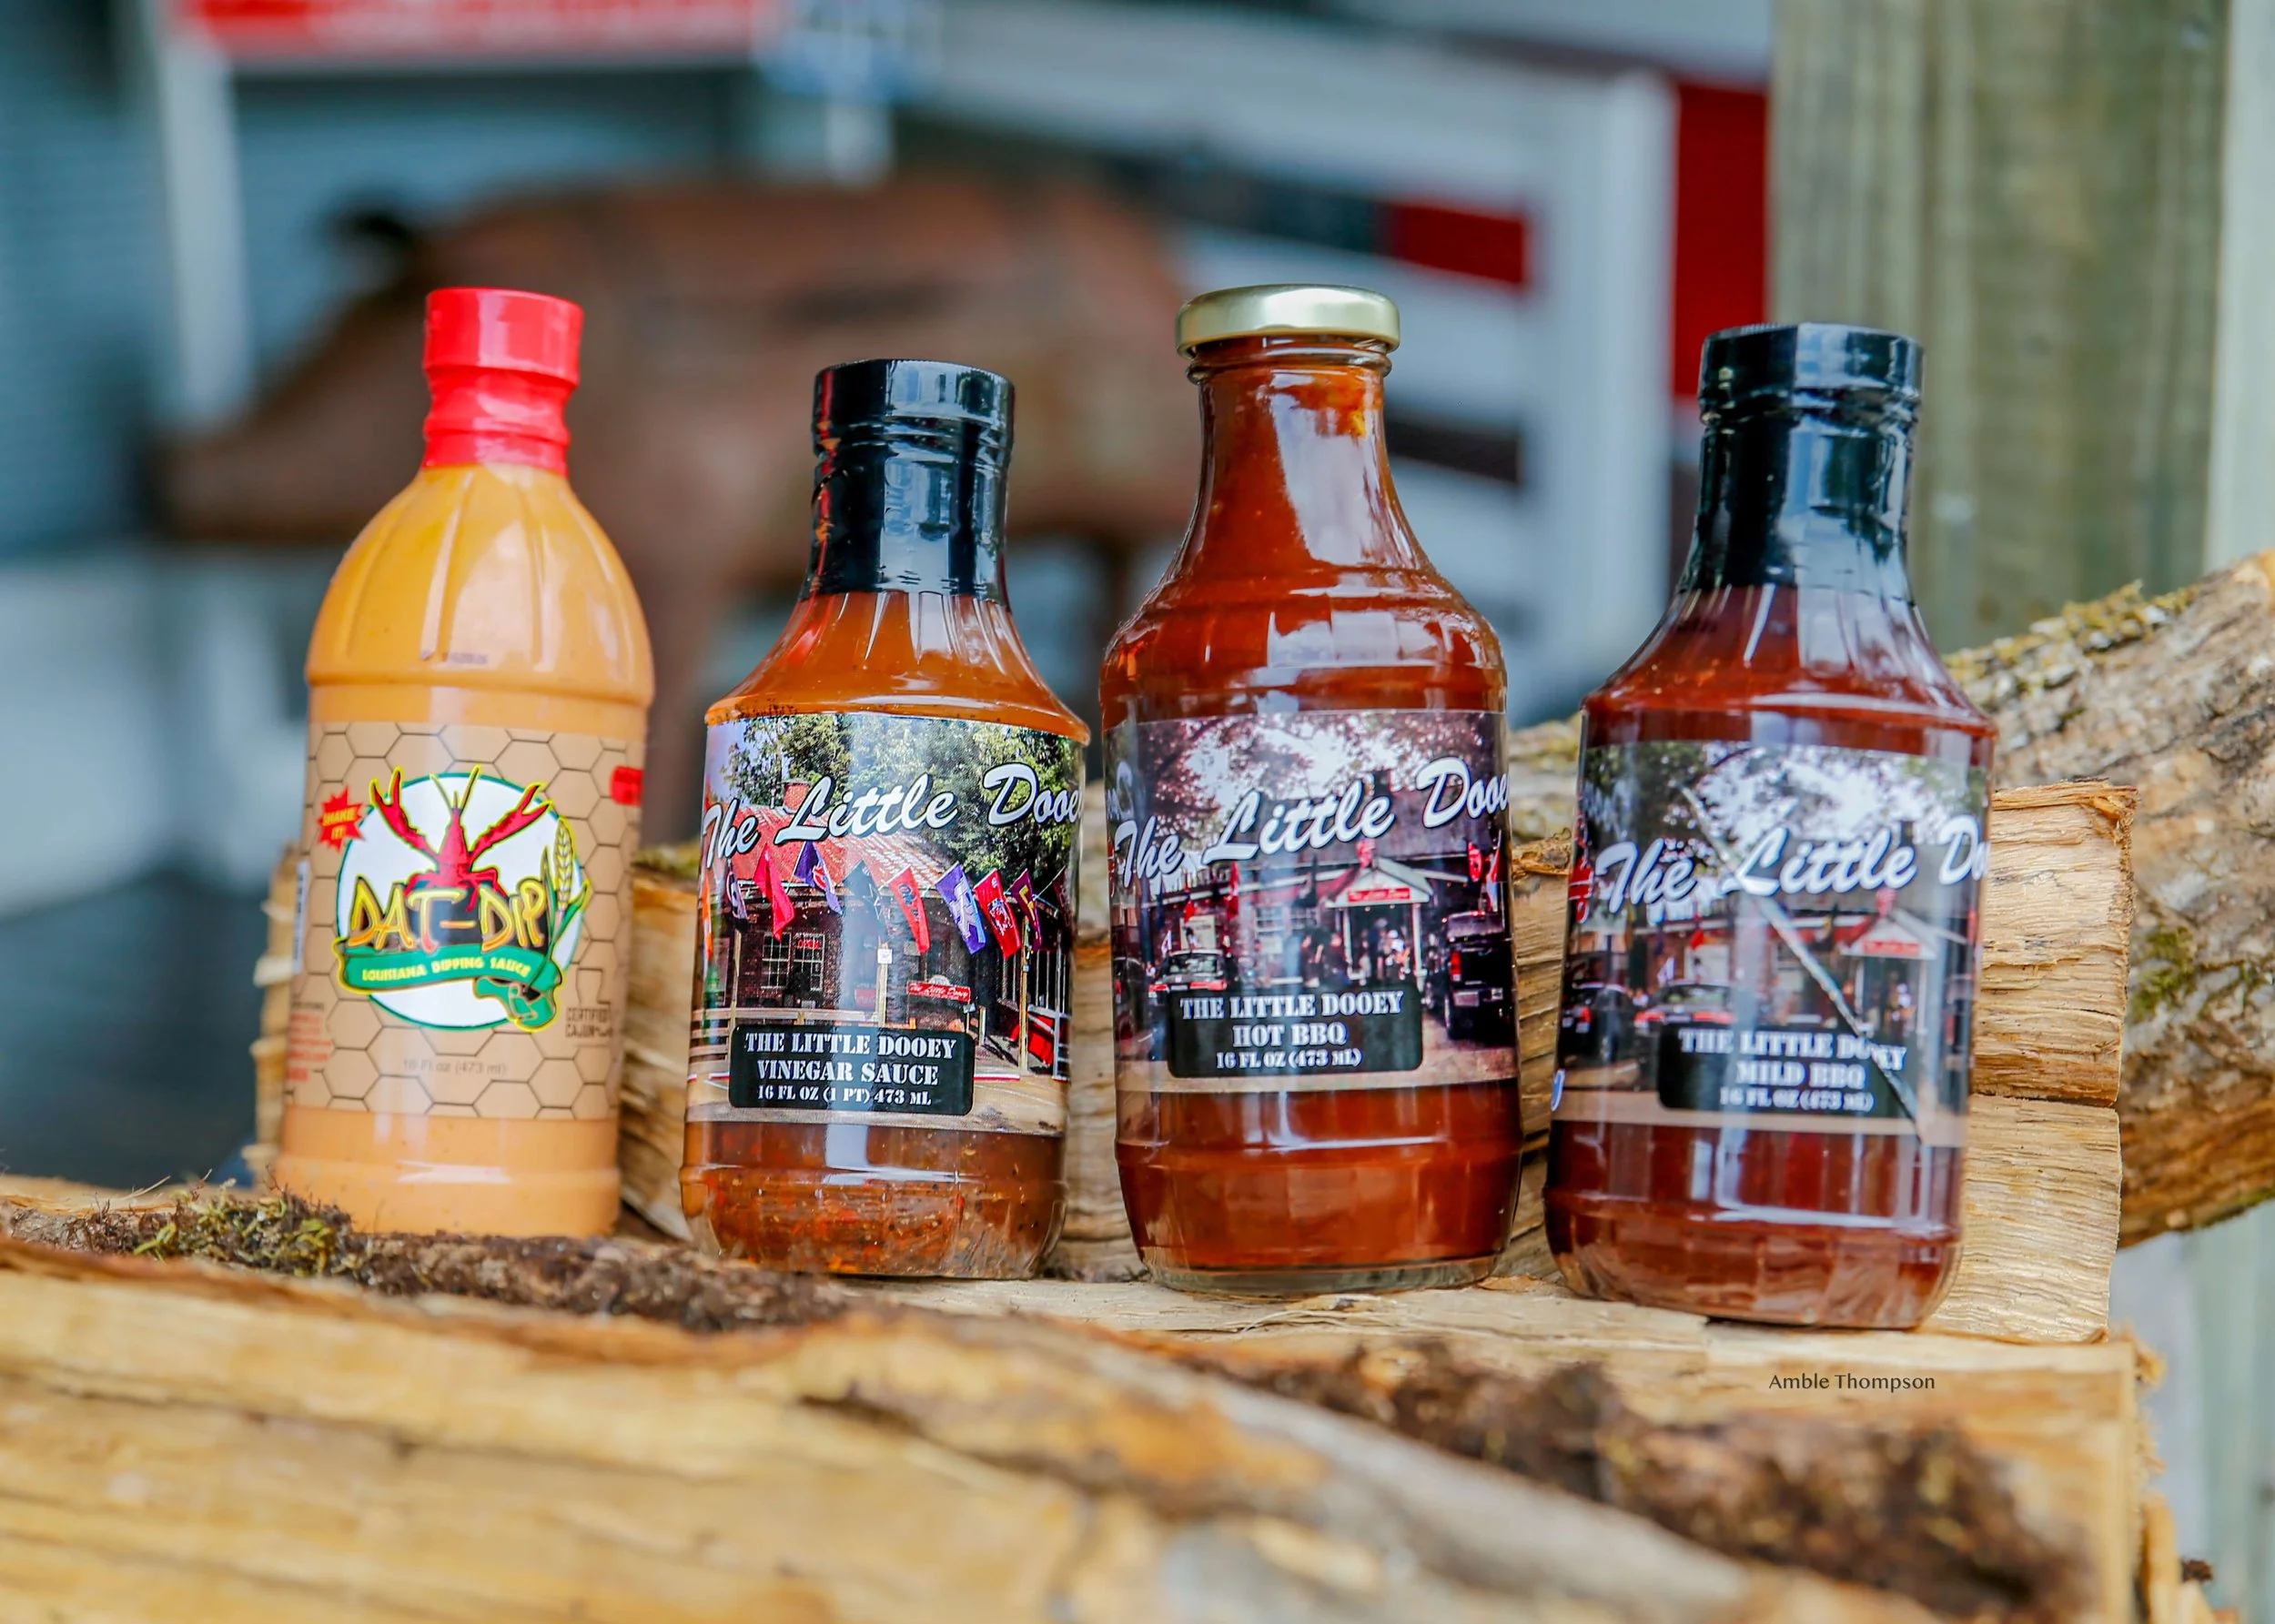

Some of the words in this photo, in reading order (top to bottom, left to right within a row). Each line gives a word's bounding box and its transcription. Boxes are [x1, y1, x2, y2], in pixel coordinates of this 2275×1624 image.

[703, 799, 760, 869] The
[774, 773, 958, 845] Little
[1115, 815, 1186, 889] The
[1201, 777, 1397, 865] Little
[1595, 837, 1698, 913] The
[1720, 826, 1917, 896] Little
[362, 963, 428, 981] LOUISIANA
[431, 956, 485, 973] DIPPING
[490, 956, 531, 978] SAUCE
[1180, 997, 1225, 1020] THE
[1229, 994, 1316, 1019] LITTLE
[1321, 991, 1404, 1016] DOOEY
[745, 1032, 785, 1053] THE
[791, 1034, 871, 1055] LITTLE
[877, 1034, 957, 1060] DOOEY
[1232, 1024, 1286, 1047] HOT
[1290, 1022, 1349, 1047] BBQ
[1678, 1028, 1734, 1054] THE
[1739, 1030, 1834, 1059] LITTLE
[757, 1059, 854, 1083] VINEGAR
[861, 1061, 939, 1086] SAUCE
[1216, 1052, 1237, 1069] 16
[1239, 1052, 1262, 1068] FL
[1263, 1051, 1287, 1068] OZ
[1288, 1049, 1329, 1068] (473
[1735, 1060, 1805, 1086] MILD
[1809, 1062, 1867, 1090] BBQ
[757, 1084, 774, 1100] 16
[777, 1085, 796, 1100] FL
[799, 1086, 819, 1102] OZ
[822, 1087, 837, 1103] (1
[843, 1087, 870, 1104] PT)
[874, 1089, 905, 1105] 473
